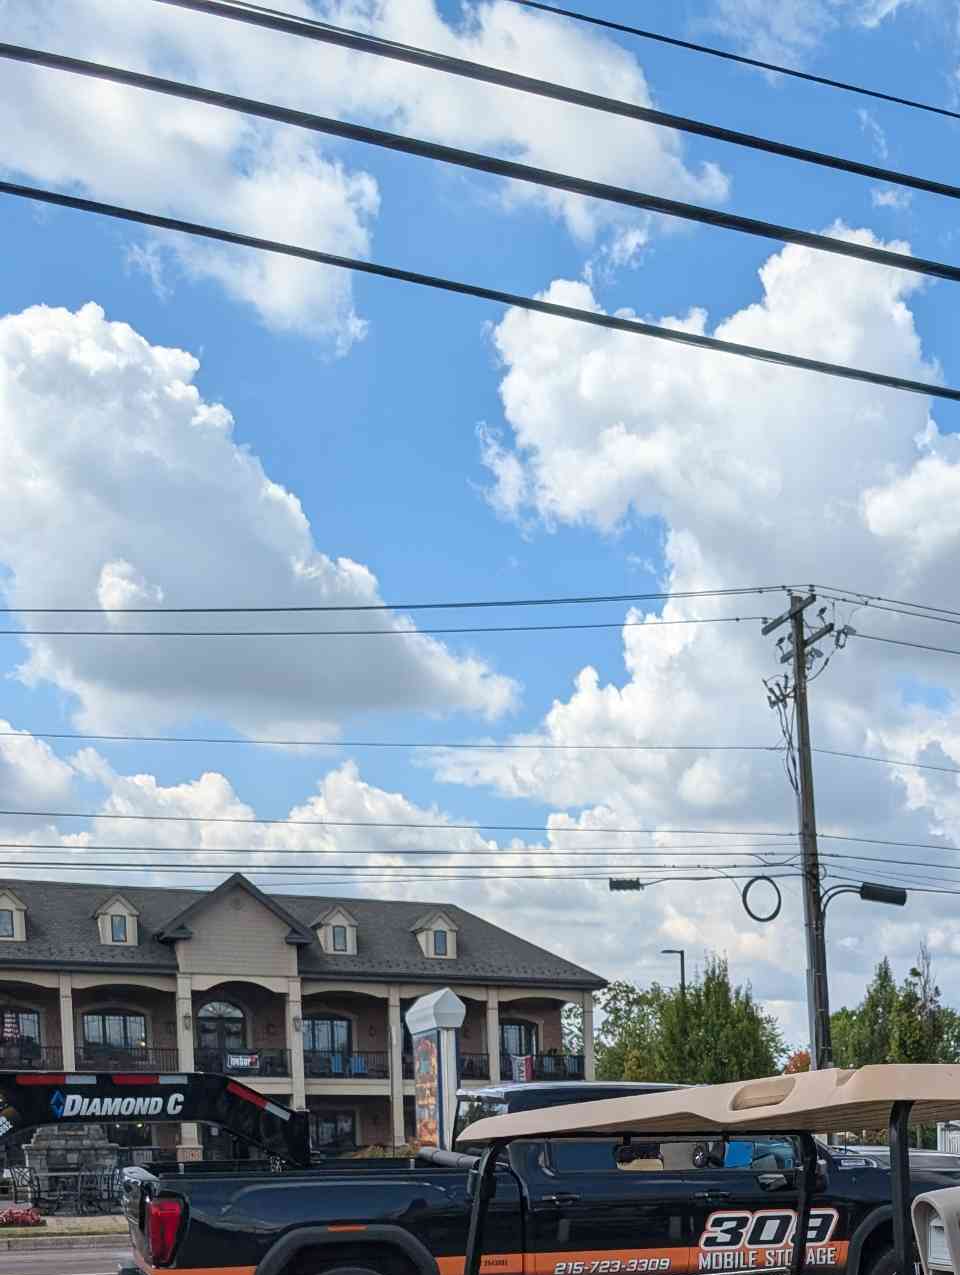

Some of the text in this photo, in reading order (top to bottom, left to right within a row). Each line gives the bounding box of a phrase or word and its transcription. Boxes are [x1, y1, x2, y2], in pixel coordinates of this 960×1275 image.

[63, 1093, 185, 1117] DIAMOND C
[554, 1258, 670, 1275] 215-723-3309
[698, 1247, 836, 1270] MOBILE STOAGE
